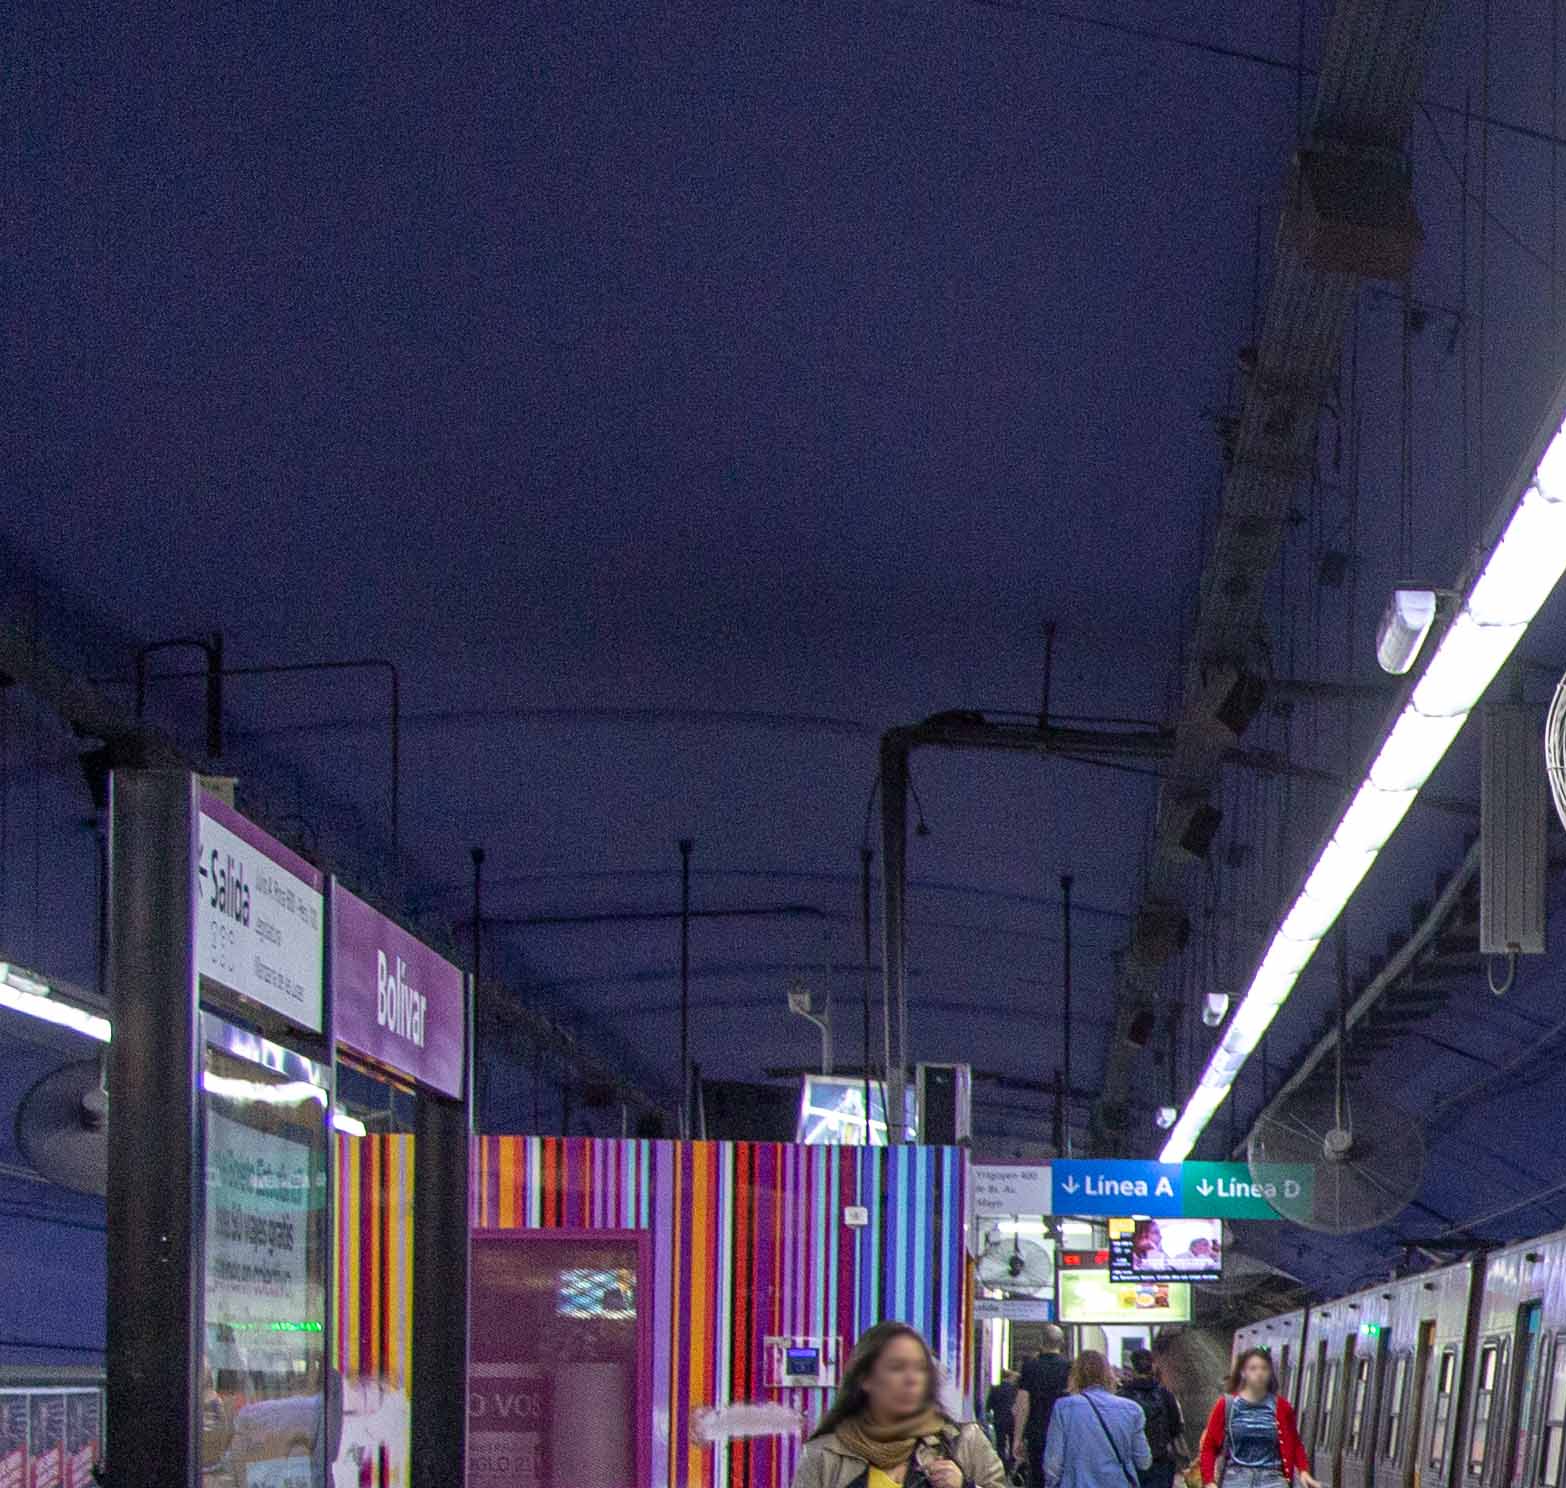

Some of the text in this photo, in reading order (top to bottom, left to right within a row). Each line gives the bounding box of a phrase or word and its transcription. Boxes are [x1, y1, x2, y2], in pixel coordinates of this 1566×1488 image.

[211, 848, 250, 928] Salida
[377, 949, 427, 1048] Bolívar
[1084, 1174, 1174, 1197] Línea A
[1216, 1174, 1300, 1198] Línea D
[494, 1392, 541, 1418] VOS
